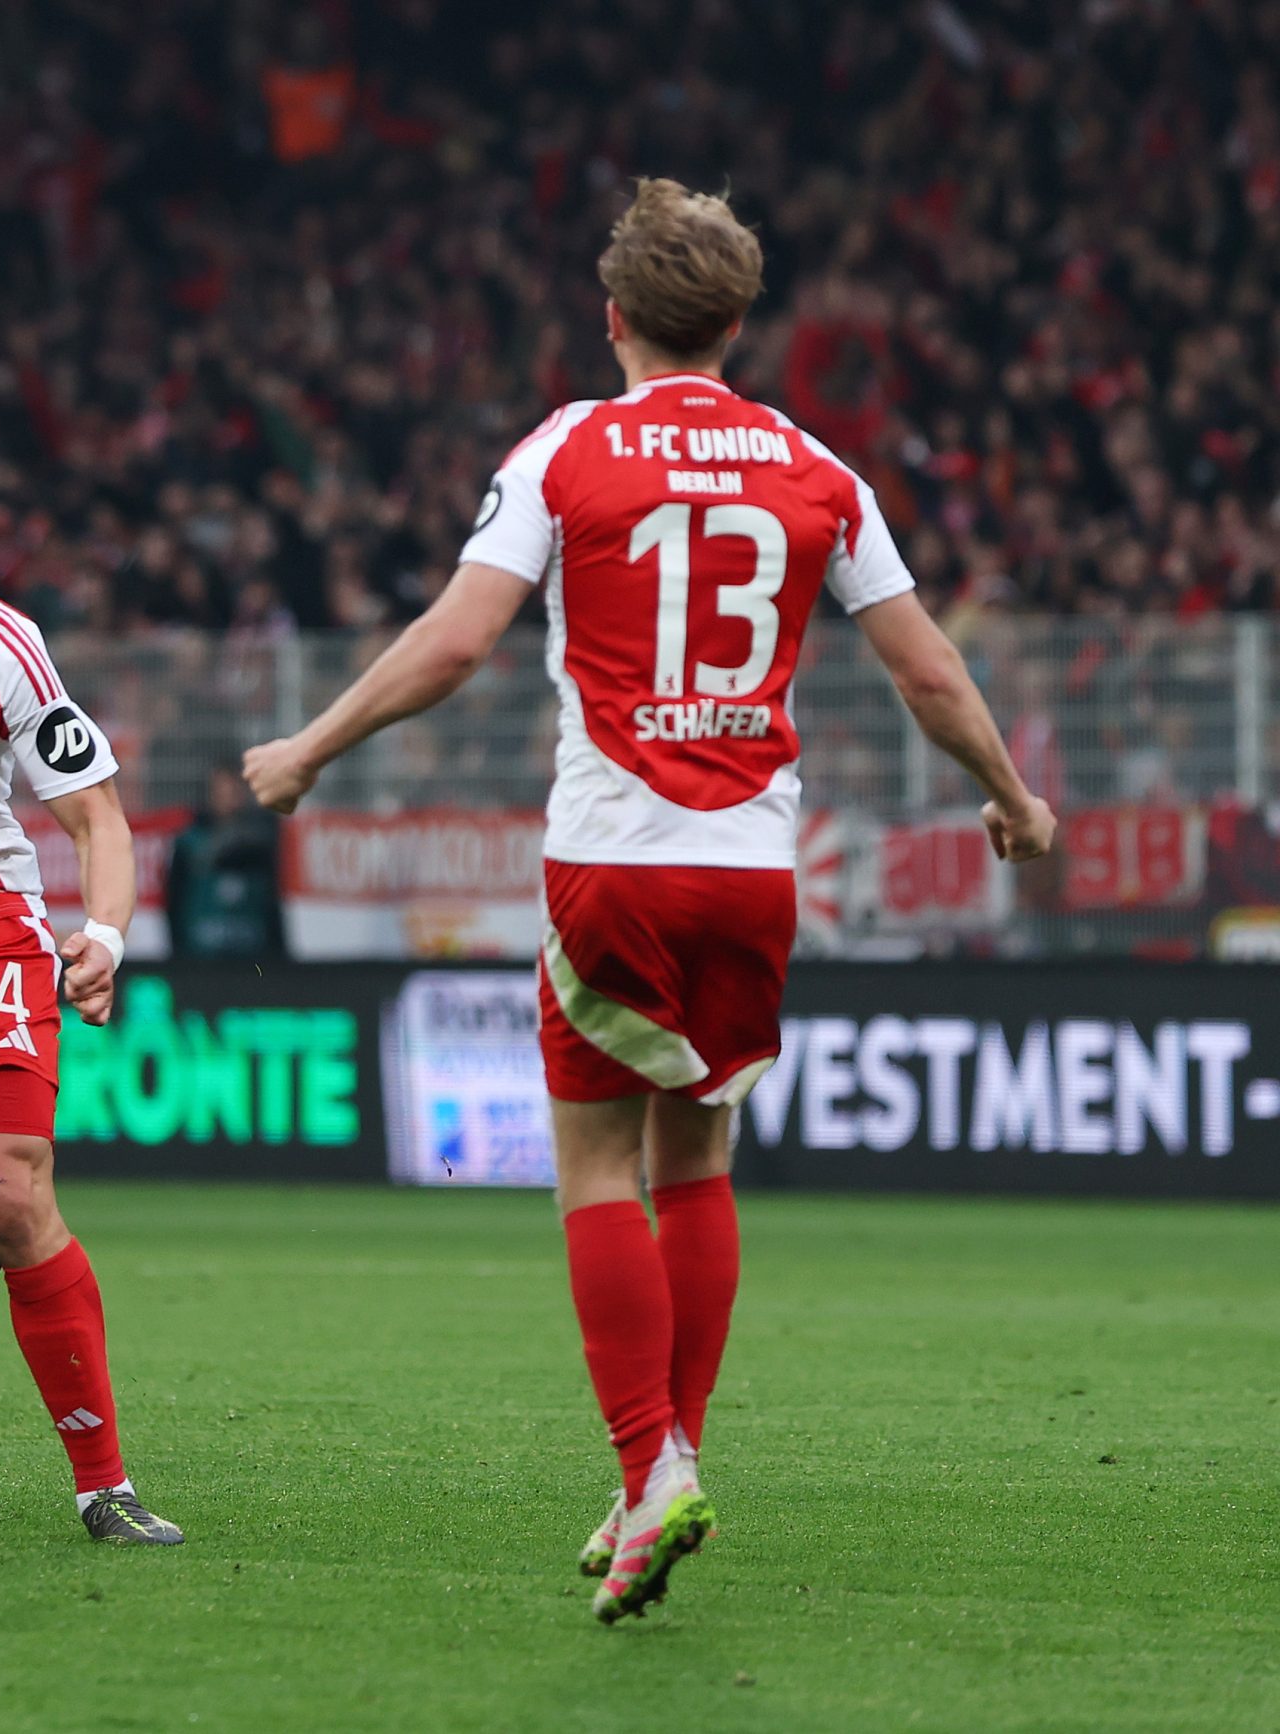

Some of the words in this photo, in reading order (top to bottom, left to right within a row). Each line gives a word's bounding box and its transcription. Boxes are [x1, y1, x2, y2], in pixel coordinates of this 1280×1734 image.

[605, 422, 635, 458] 1.
[640, 423, 682, 461] FC
[687, 425, 793, 465] UNION
[667, 469, 744, 495] BERLIN
[628, 502, 788, 700] 13
[48, 718, 90, 764] JD
[633, 698, 771, 742] SCHÄFER
